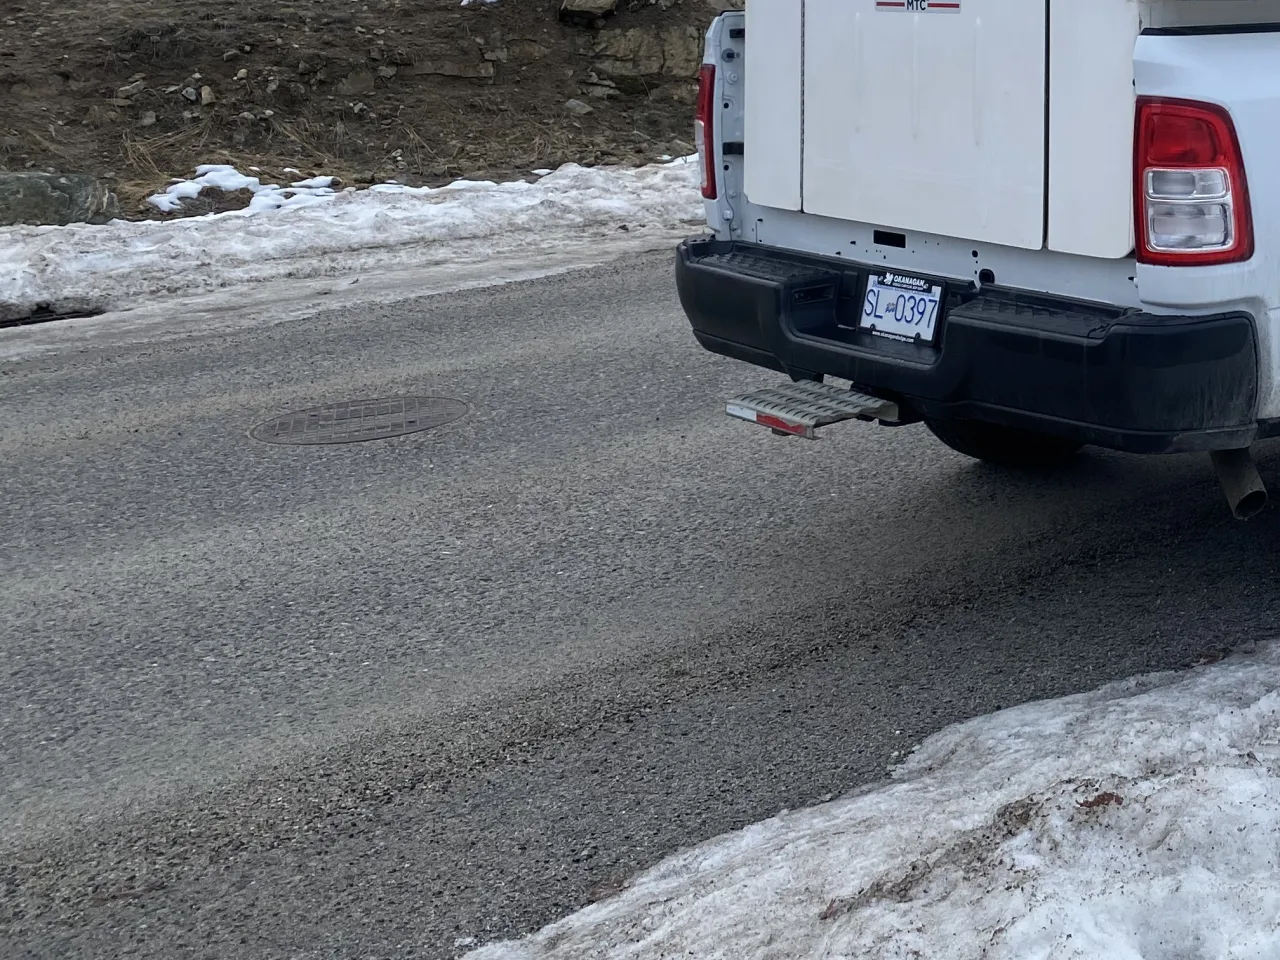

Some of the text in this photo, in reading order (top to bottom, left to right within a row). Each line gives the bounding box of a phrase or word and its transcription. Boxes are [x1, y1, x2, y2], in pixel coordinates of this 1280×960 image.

[894, 275, 925, 287] OKANAGAN
[864, 289, 938, 329] SL 0397
